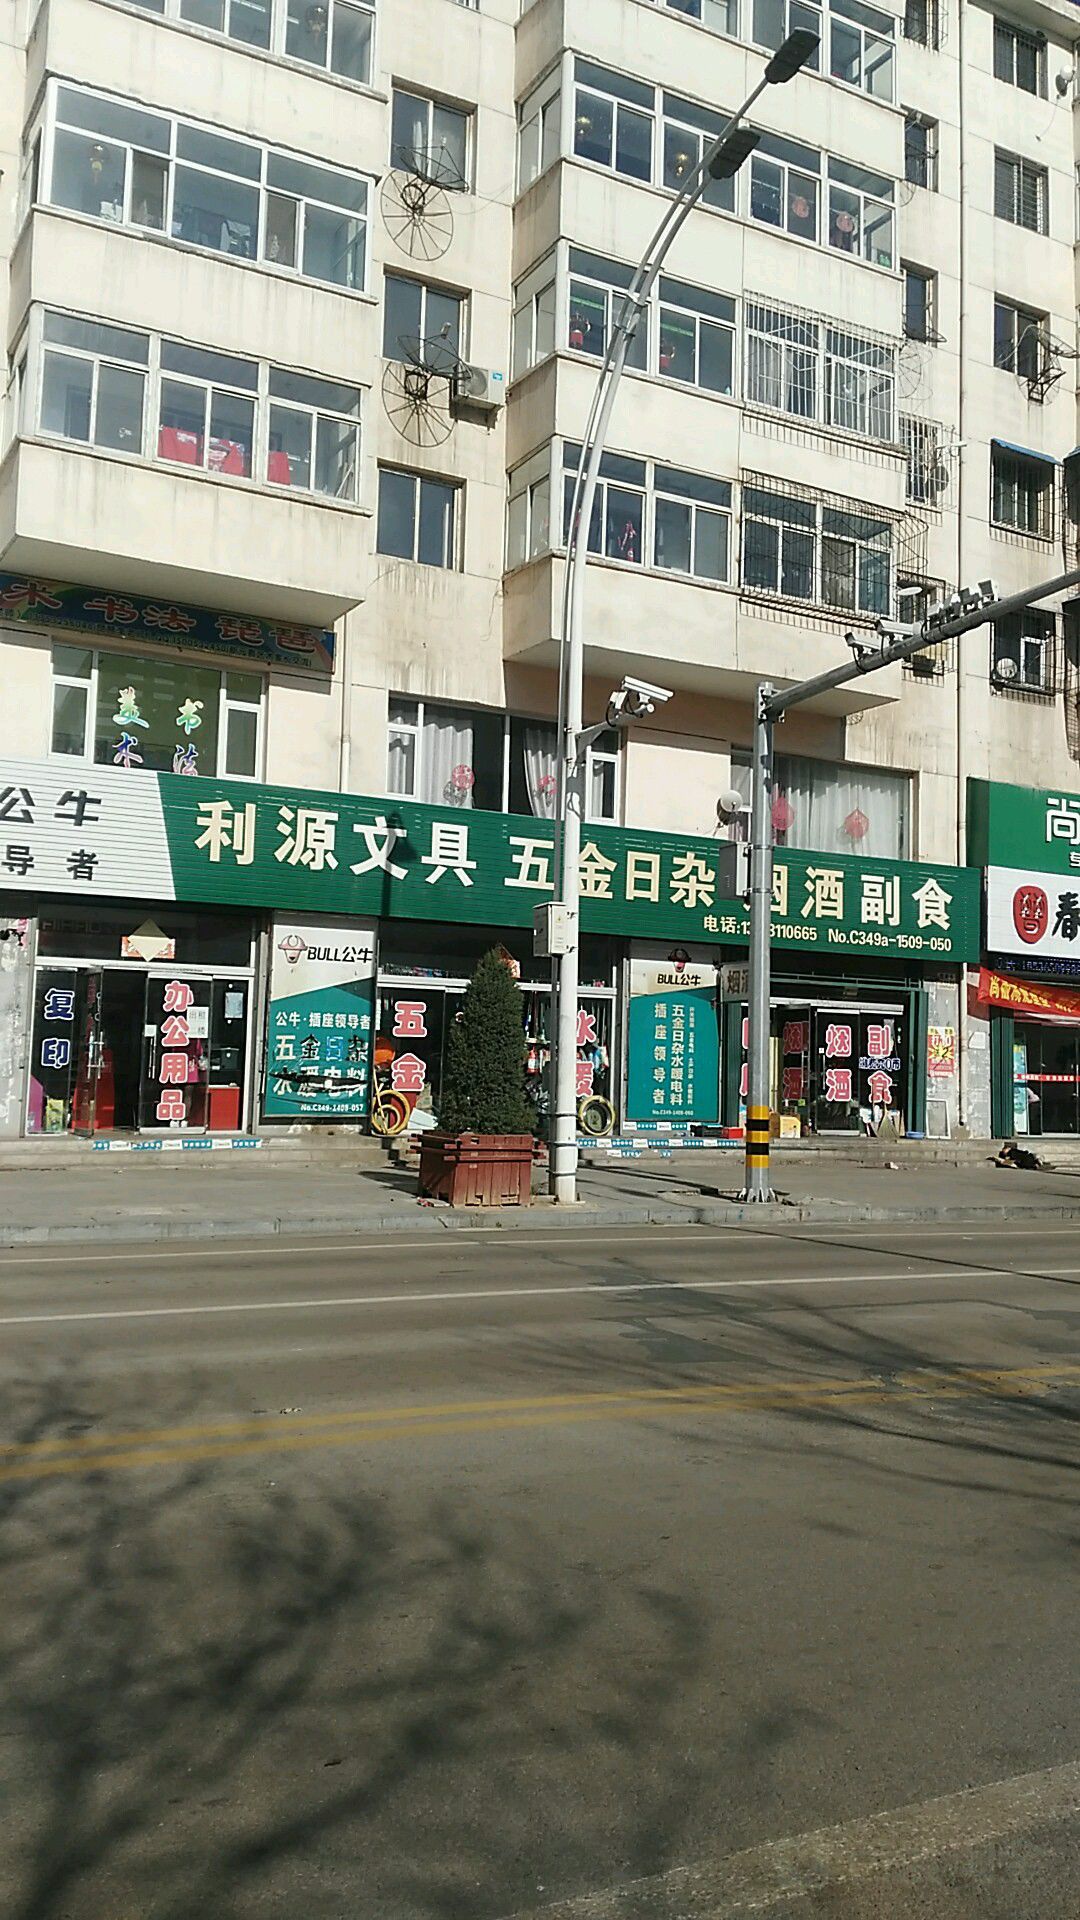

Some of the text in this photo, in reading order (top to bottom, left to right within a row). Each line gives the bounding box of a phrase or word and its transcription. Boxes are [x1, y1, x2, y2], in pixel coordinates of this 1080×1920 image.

[83, 595, 197, 633] 书法
[214, 615, 317, 655] 琵琶
[111, 686, 150, 768] 美术
[172, 698, 204, 776] 书法
[0, 786, 102, 827] 公牛
[1046, 797, 1080, 845] 尚
[1, 844, 98, 881] 导者
[306, 946, 374, 963] BULL公牛
[657, 973, 701, 986] BULL公牛
[828, 929, 952, 952] No.C349a-1509-050
[41, 988, 74, 1069] 复印
[156, 980, 194, 1121] 办公用品
[391, 1000, 427, 1092] 五金
[653, 1003, 667, 1105] 插座领导者
[670, 1004, 685, 1106] 五金日杂水暖电料
[826, 1024, 852, 1102] 烟酒
[867, 1024, 894, 1104] 副食
